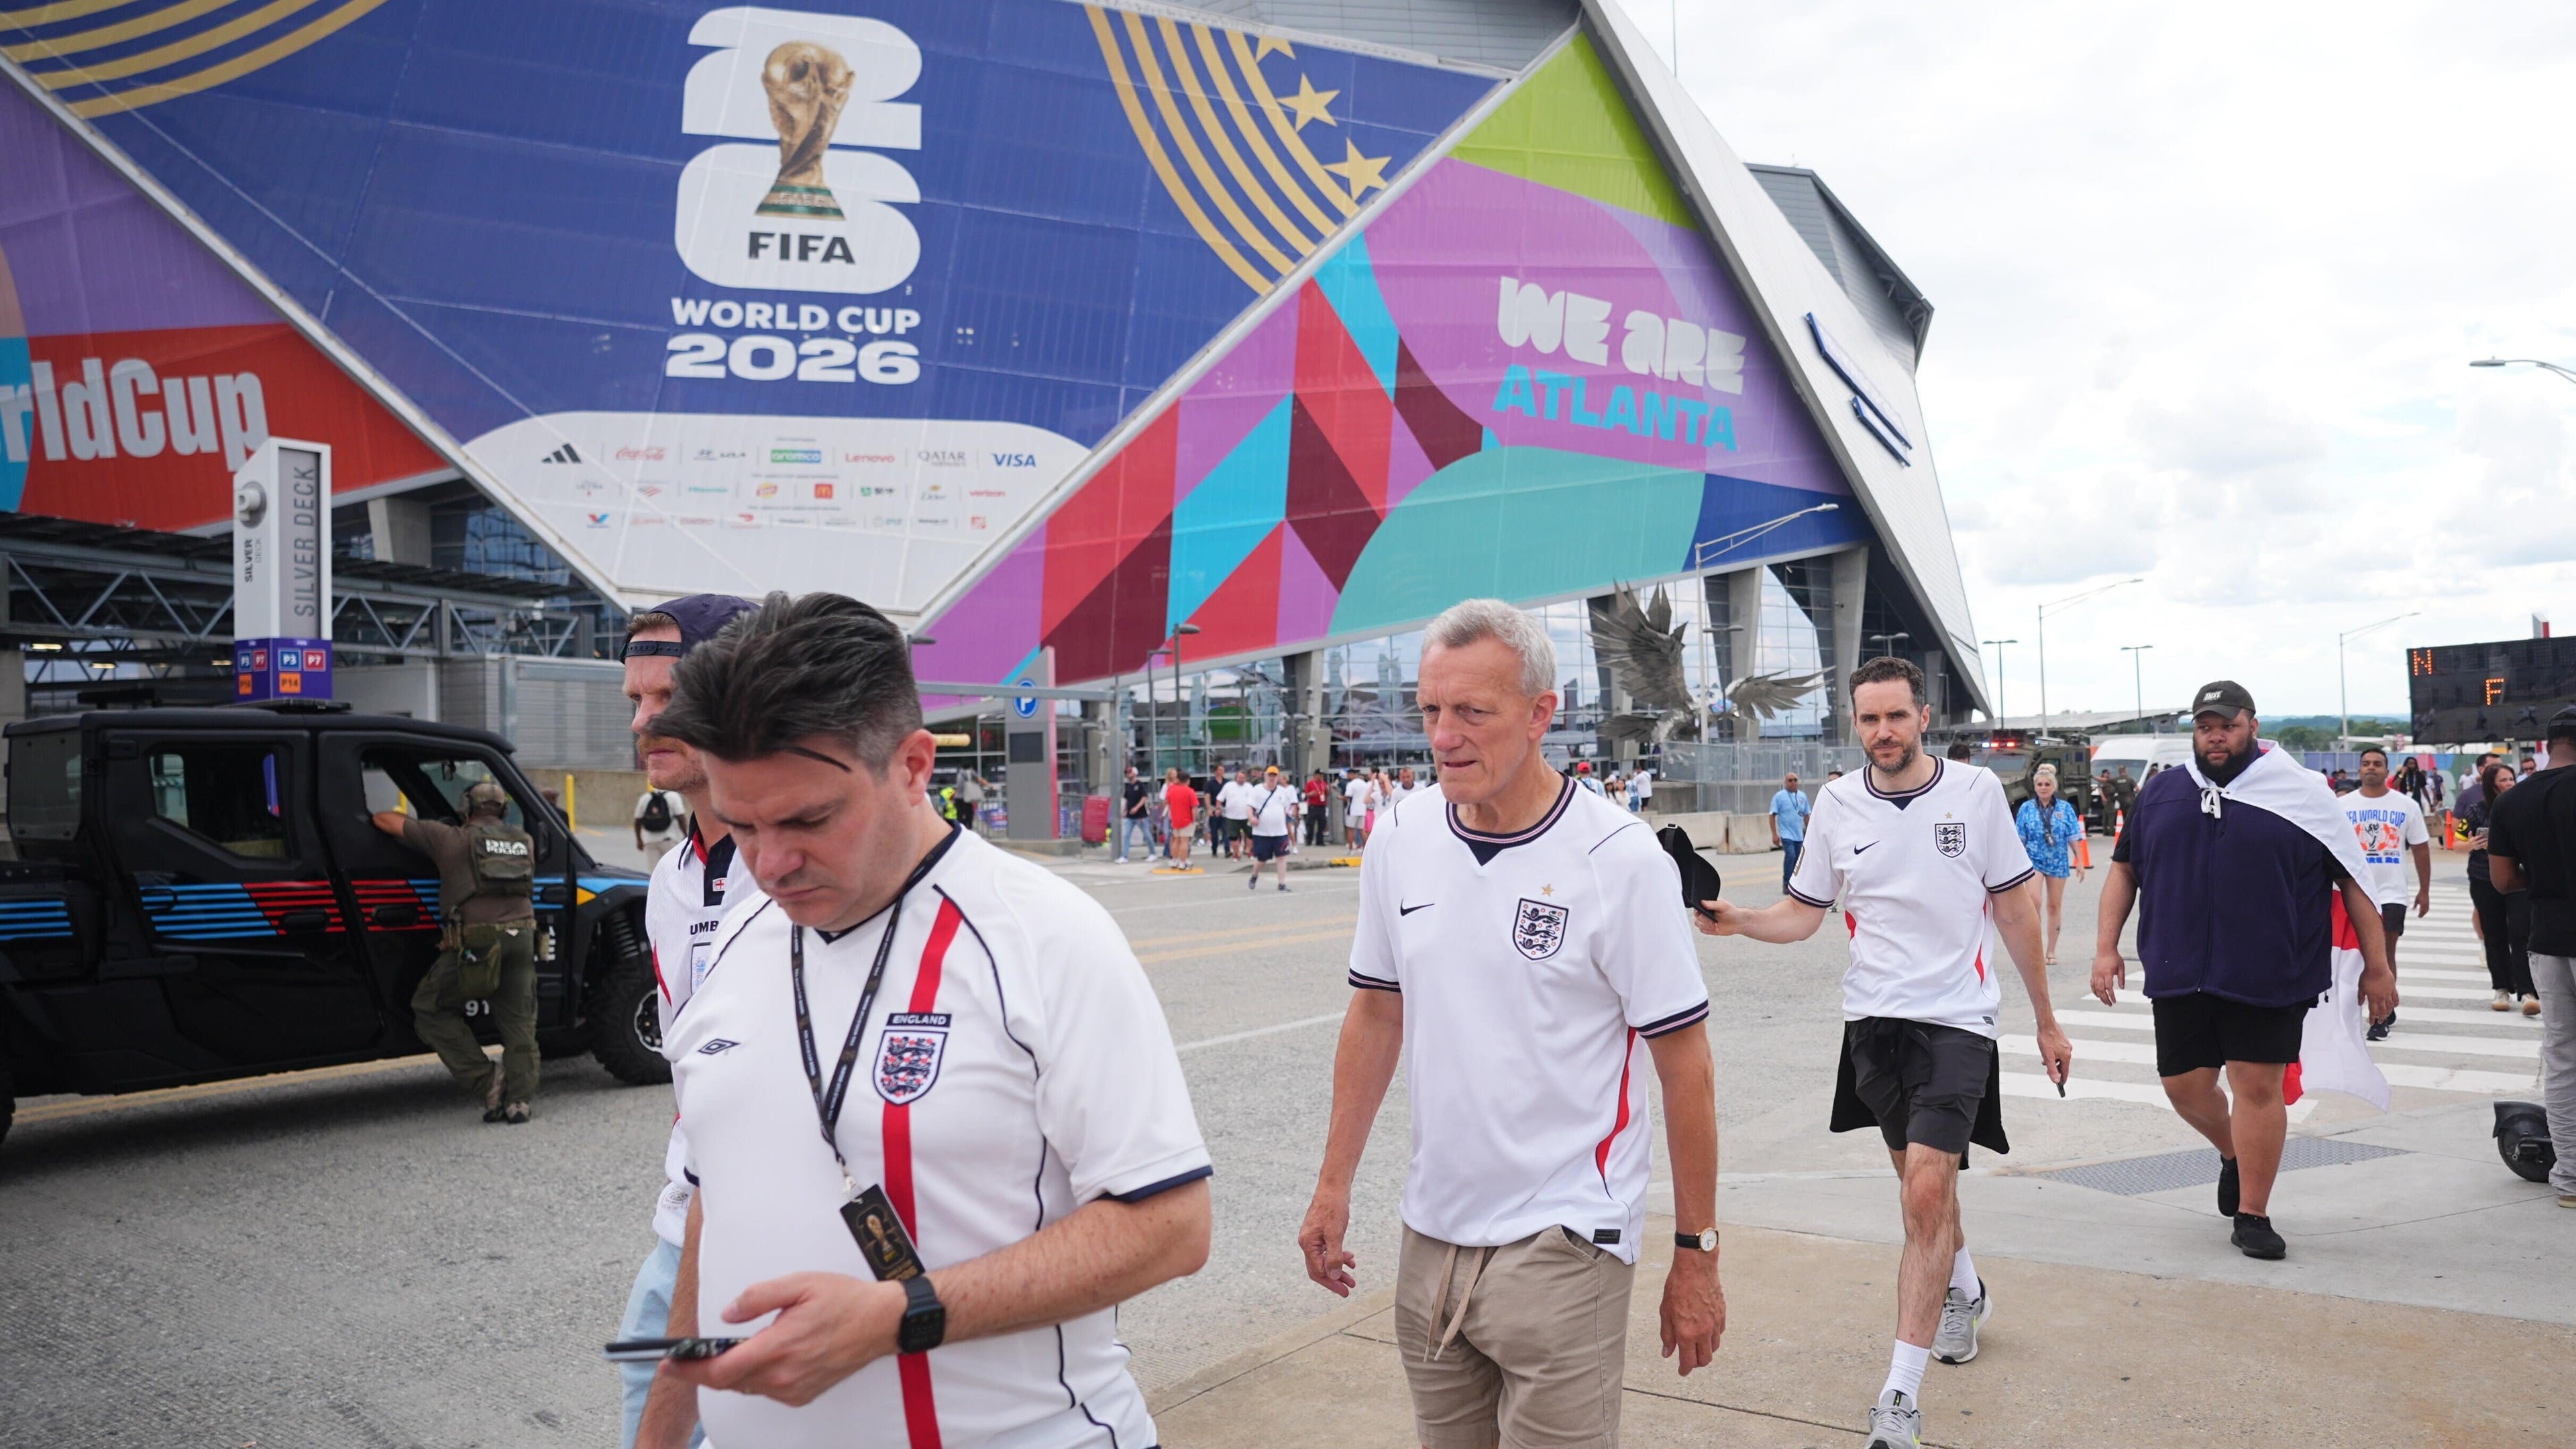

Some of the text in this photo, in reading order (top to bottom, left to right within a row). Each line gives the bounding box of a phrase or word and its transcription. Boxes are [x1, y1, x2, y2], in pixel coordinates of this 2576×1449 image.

[748, 231, 855, 264] FIFA
[670, 298, 922, 335] WORLD CUP
[1497, 276, 1613, 367] WE
[665, 333, 922, 385] 2026
[1492, 364, 1737, 451] ATLANTA
[772, 452, 820, 462] aramco
[845, 453, 896, 463] Lenovo
[918, 451, 967, 462] QATAR
[992, 453, 1036, 468] VISA
[294, 468, 314, 527] DECK
[244, 539, 253, 583] SILVER
[294, 537, 315, 616] SILVER
[282, 653, 322, 666] P3 P7
[2413, 649, 2433, 676] N
[282, 679, 299, 688] P14
[2485, 678, 2505, 706] F
[2346, 810, 2406, 828] FA WORLD CUP
[486, 839, 527, 850] DEA
[690, 920, 719, 935] UMB
[892, 1014, 947, 1025] ENGLAND
